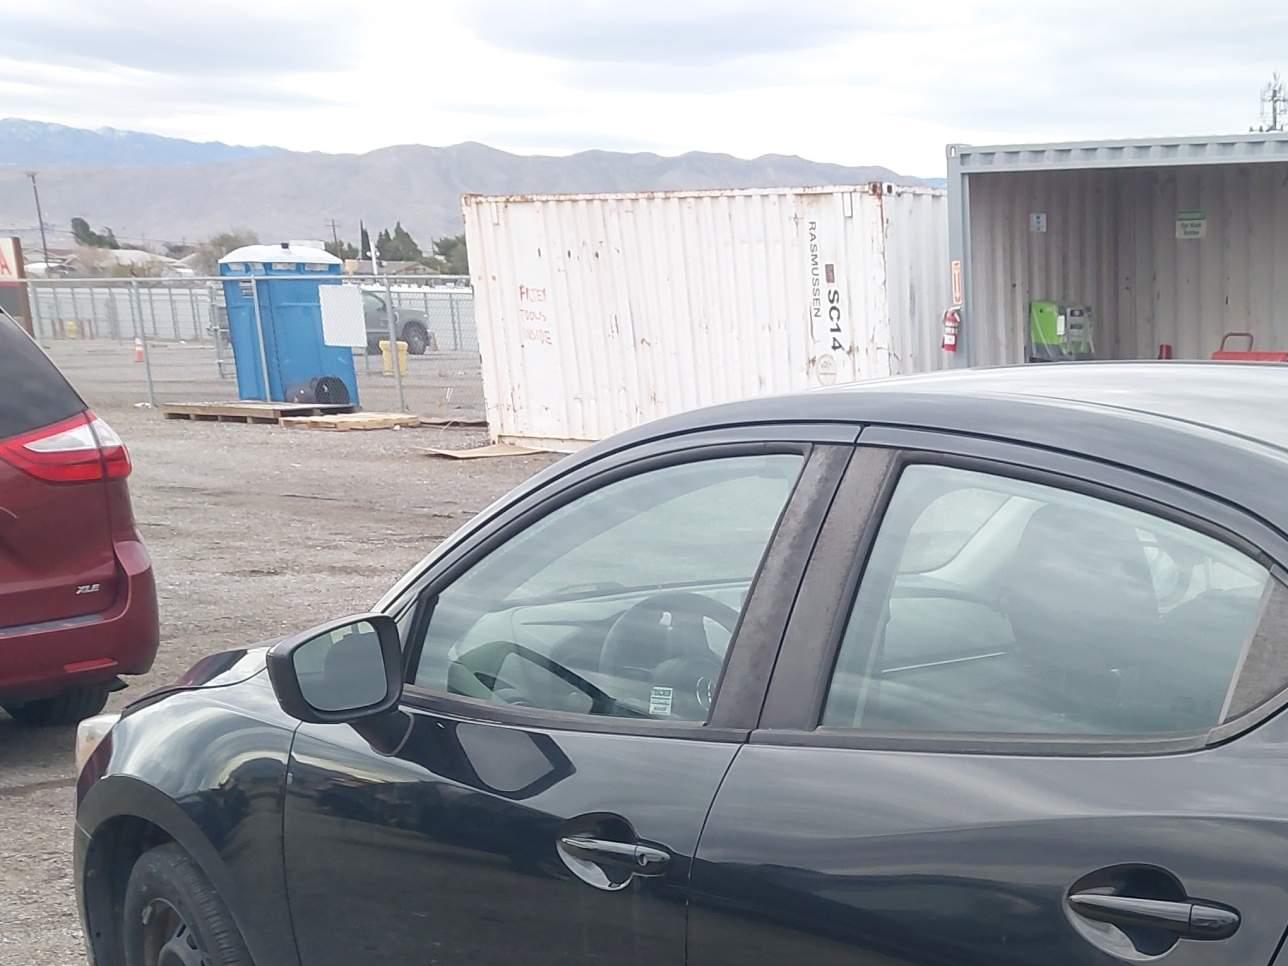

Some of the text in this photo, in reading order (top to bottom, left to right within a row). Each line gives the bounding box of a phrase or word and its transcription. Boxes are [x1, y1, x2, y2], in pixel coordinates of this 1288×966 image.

[808, 221, 821, 318] RASMUSSEN
[828, 289, 844, 352] SC14
[76, 583, 100, 594] XLE
